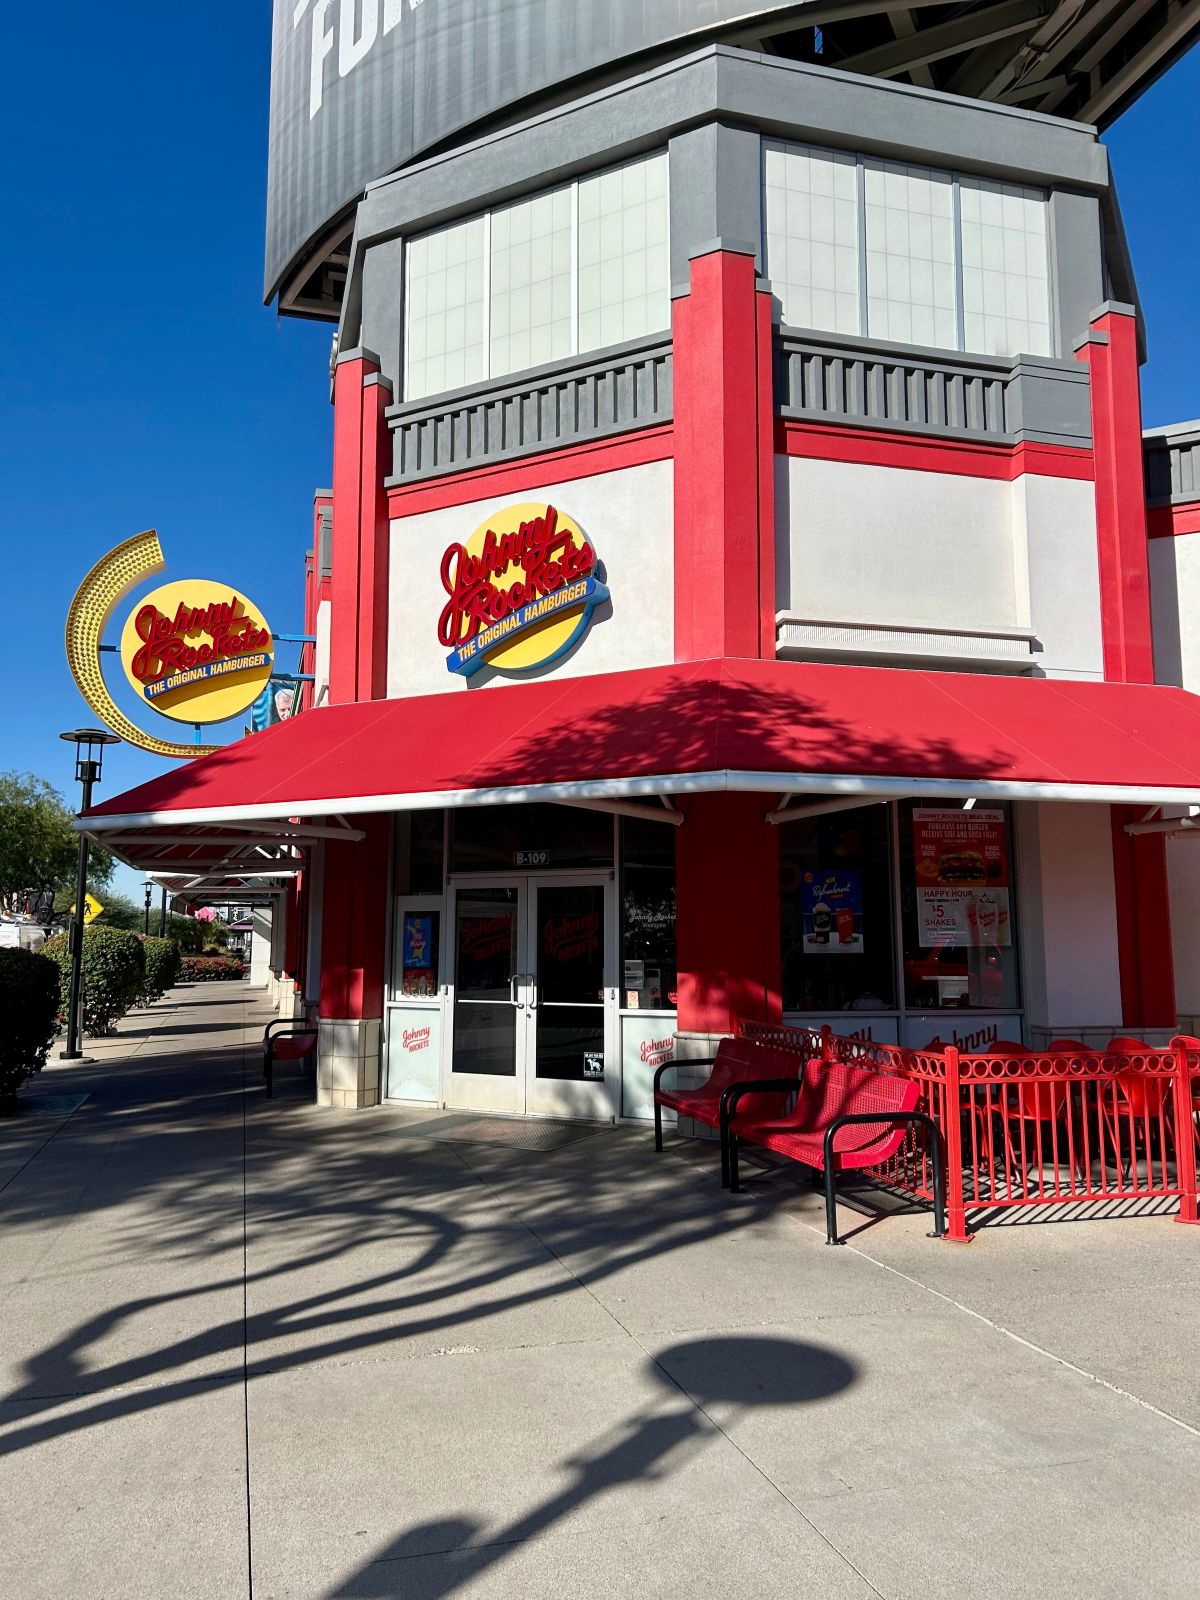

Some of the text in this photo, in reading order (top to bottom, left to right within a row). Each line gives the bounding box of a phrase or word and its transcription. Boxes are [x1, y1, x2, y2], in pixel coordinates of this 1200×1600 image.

[437, 504, 560, 647] Johnny
[457, 580, 588, 662] THE ORIGINAL HAMBURGER
[132, 596, 238, 679] Johnny
[147, 654, 266, 696] THE ORIGINAL HAMBURGER
[516, 852, 547, 864] B-109
[924, 890, 951, 898] HAPPY
[951, 890, 974, 898] HOUR
[931, 904, 945, 918] $5
[402, 1026, 430, 1048] Johnny
[409, 1040, 430, 1053] ROCKETS
[641, 1037, 674, 1062] Johnny
[649, 1052, 674, 1067] ROCKETS
